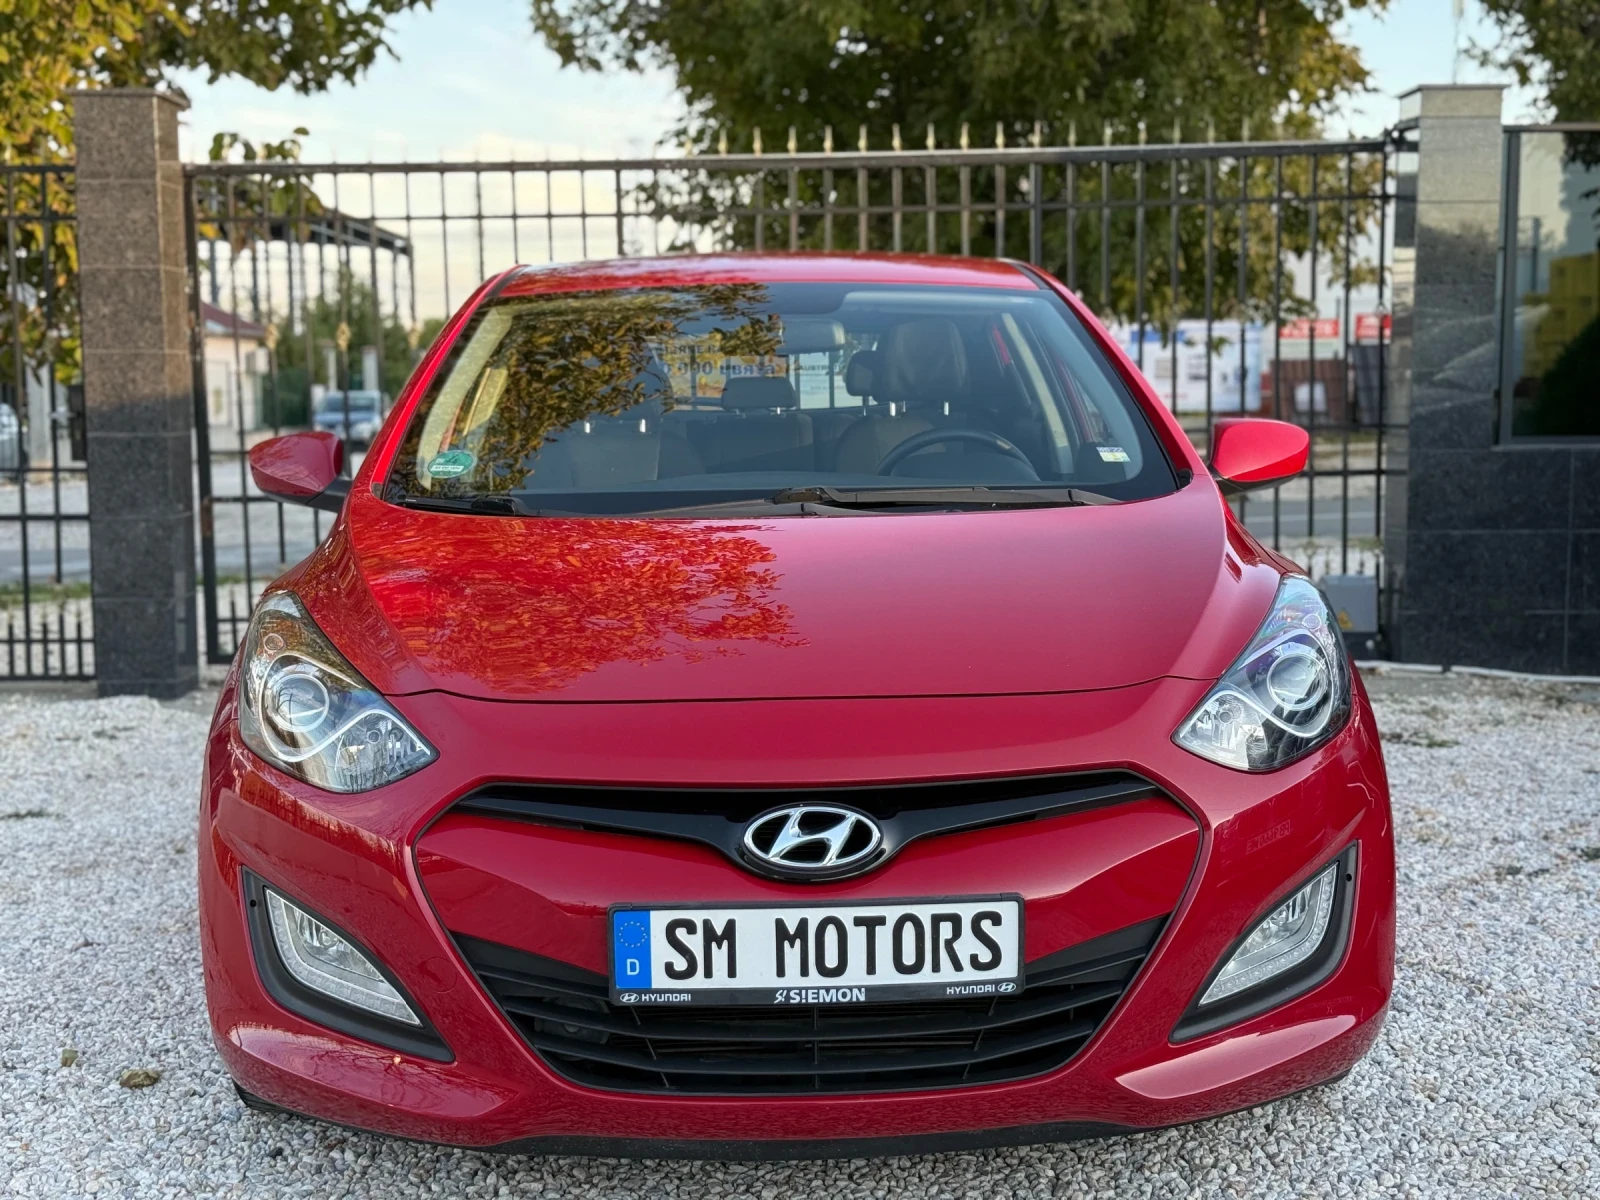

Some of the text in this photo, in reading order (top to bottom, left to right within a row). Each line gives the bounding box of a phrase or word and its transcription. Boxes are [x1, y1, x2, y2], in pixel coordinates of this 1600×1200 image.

[664, 910, 1003, 980] SM MOTORS
[626, 958, 640, 976] D
[946, 984, 996, 995] HYUNDAI
[641, 993, 692, 1002] HYUNDAI
